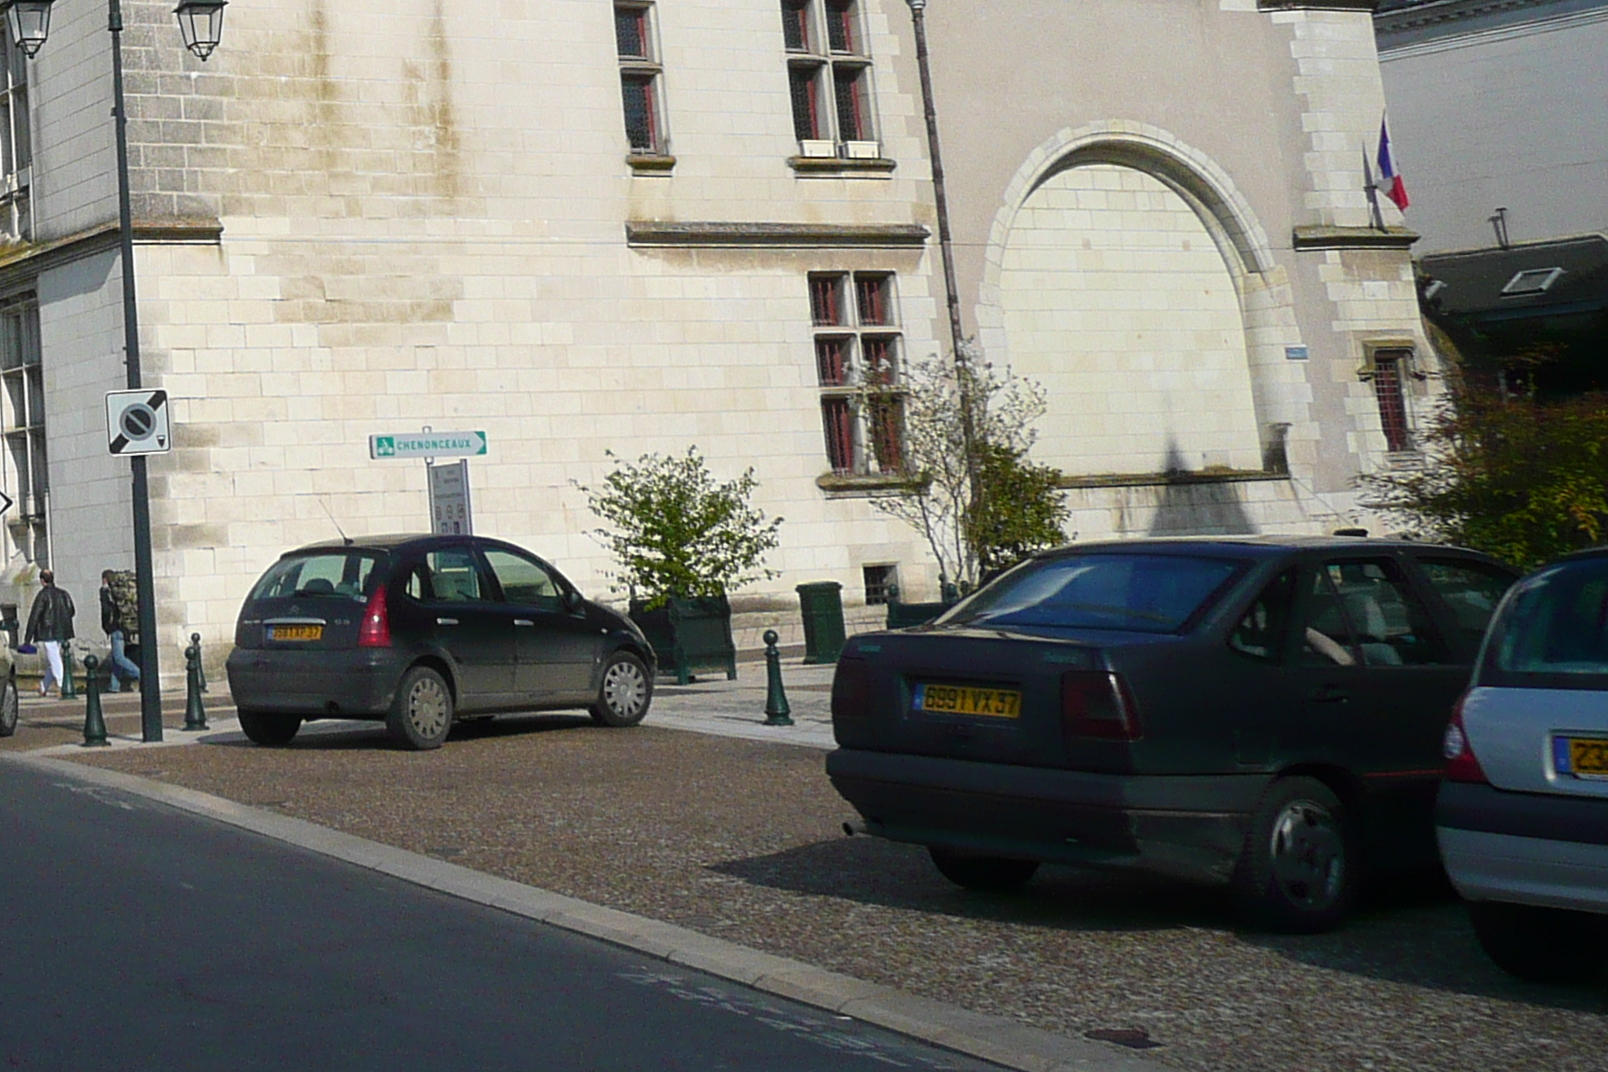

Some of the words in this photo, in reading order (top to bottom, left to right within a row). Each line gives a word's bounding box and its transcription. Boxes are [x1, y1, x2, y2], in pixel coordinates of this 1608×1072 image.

[396, 438, 471, 451] CHENONCEAUX
[924, 686, 966, 711] 6991
[972, 689, 996, 713] VX
[996, 691, 1018, 715] 37
